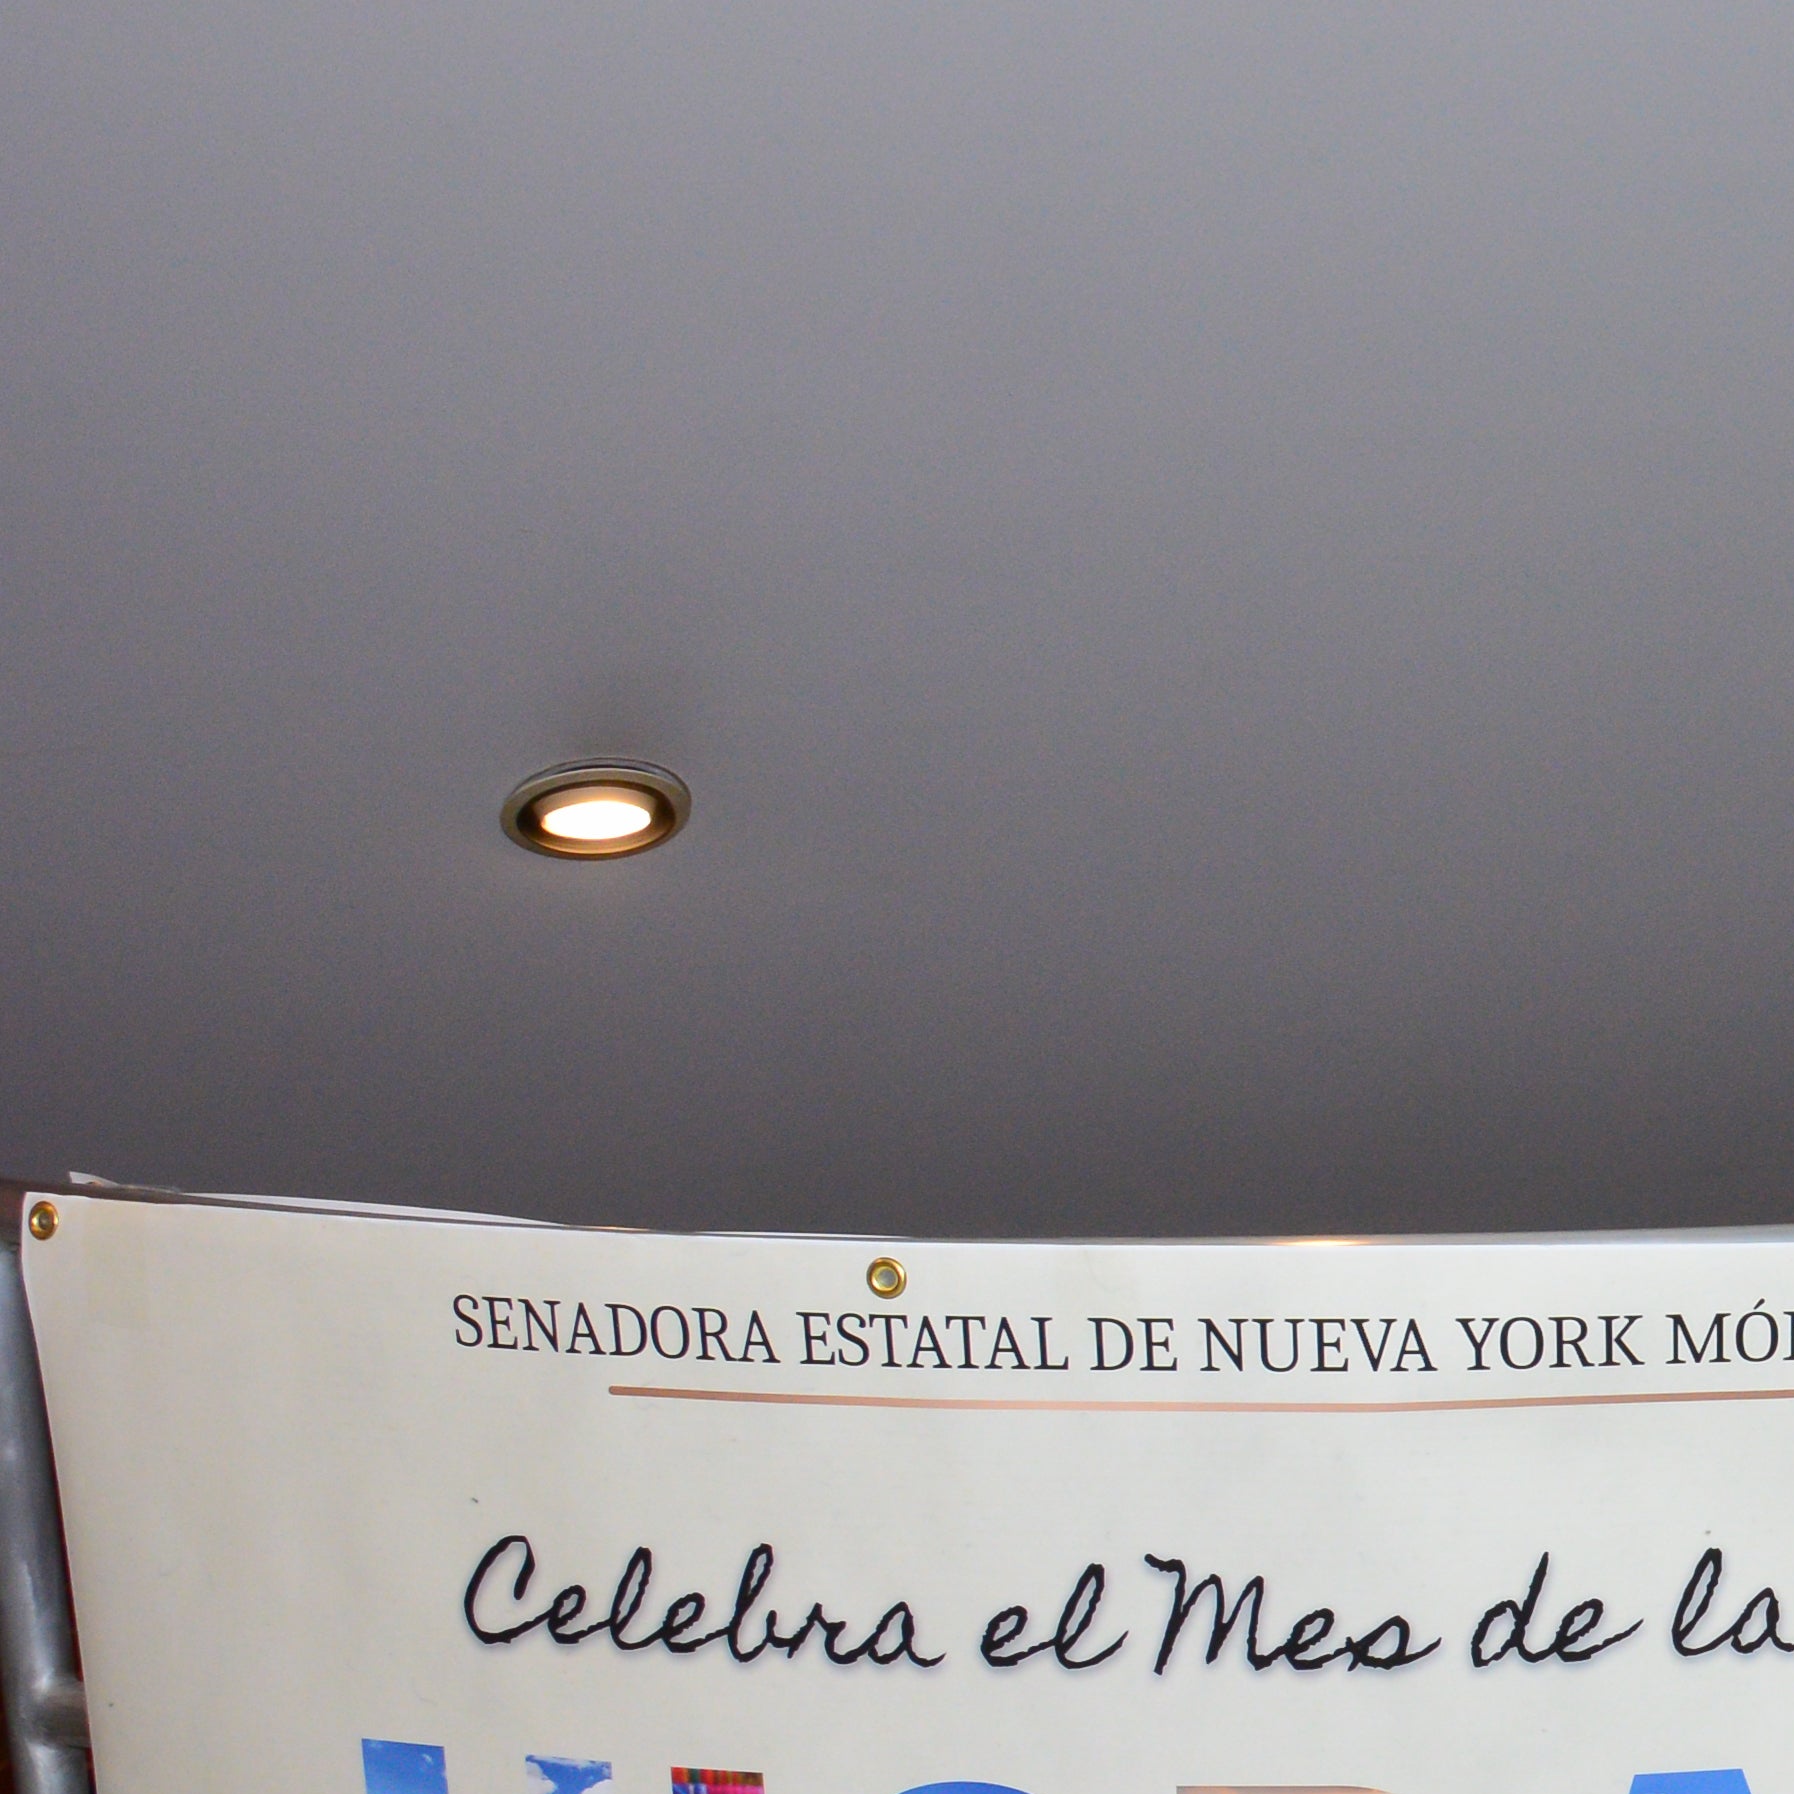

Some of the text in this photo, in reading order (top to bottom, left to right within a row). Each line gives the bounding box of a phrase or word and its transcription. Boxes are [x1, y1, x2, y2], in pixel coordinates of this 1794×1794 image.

[451, 1293, 781, 1365] SENADORA
[795, 1310, 1070, 1372] ESTATAL
[1090, 1316, 1177, 1374] DE
[1199, 1317, 1439, 1375] NUEVA
[1457, 1314, 1645, 1374] YORK
[462, 1533, 946, 1671] Celebra
[979, 1562, 1129, 1671] el
[1143, 1552, 1443, 1677] Mes
[1469, 1550, 1644, 1671] de
